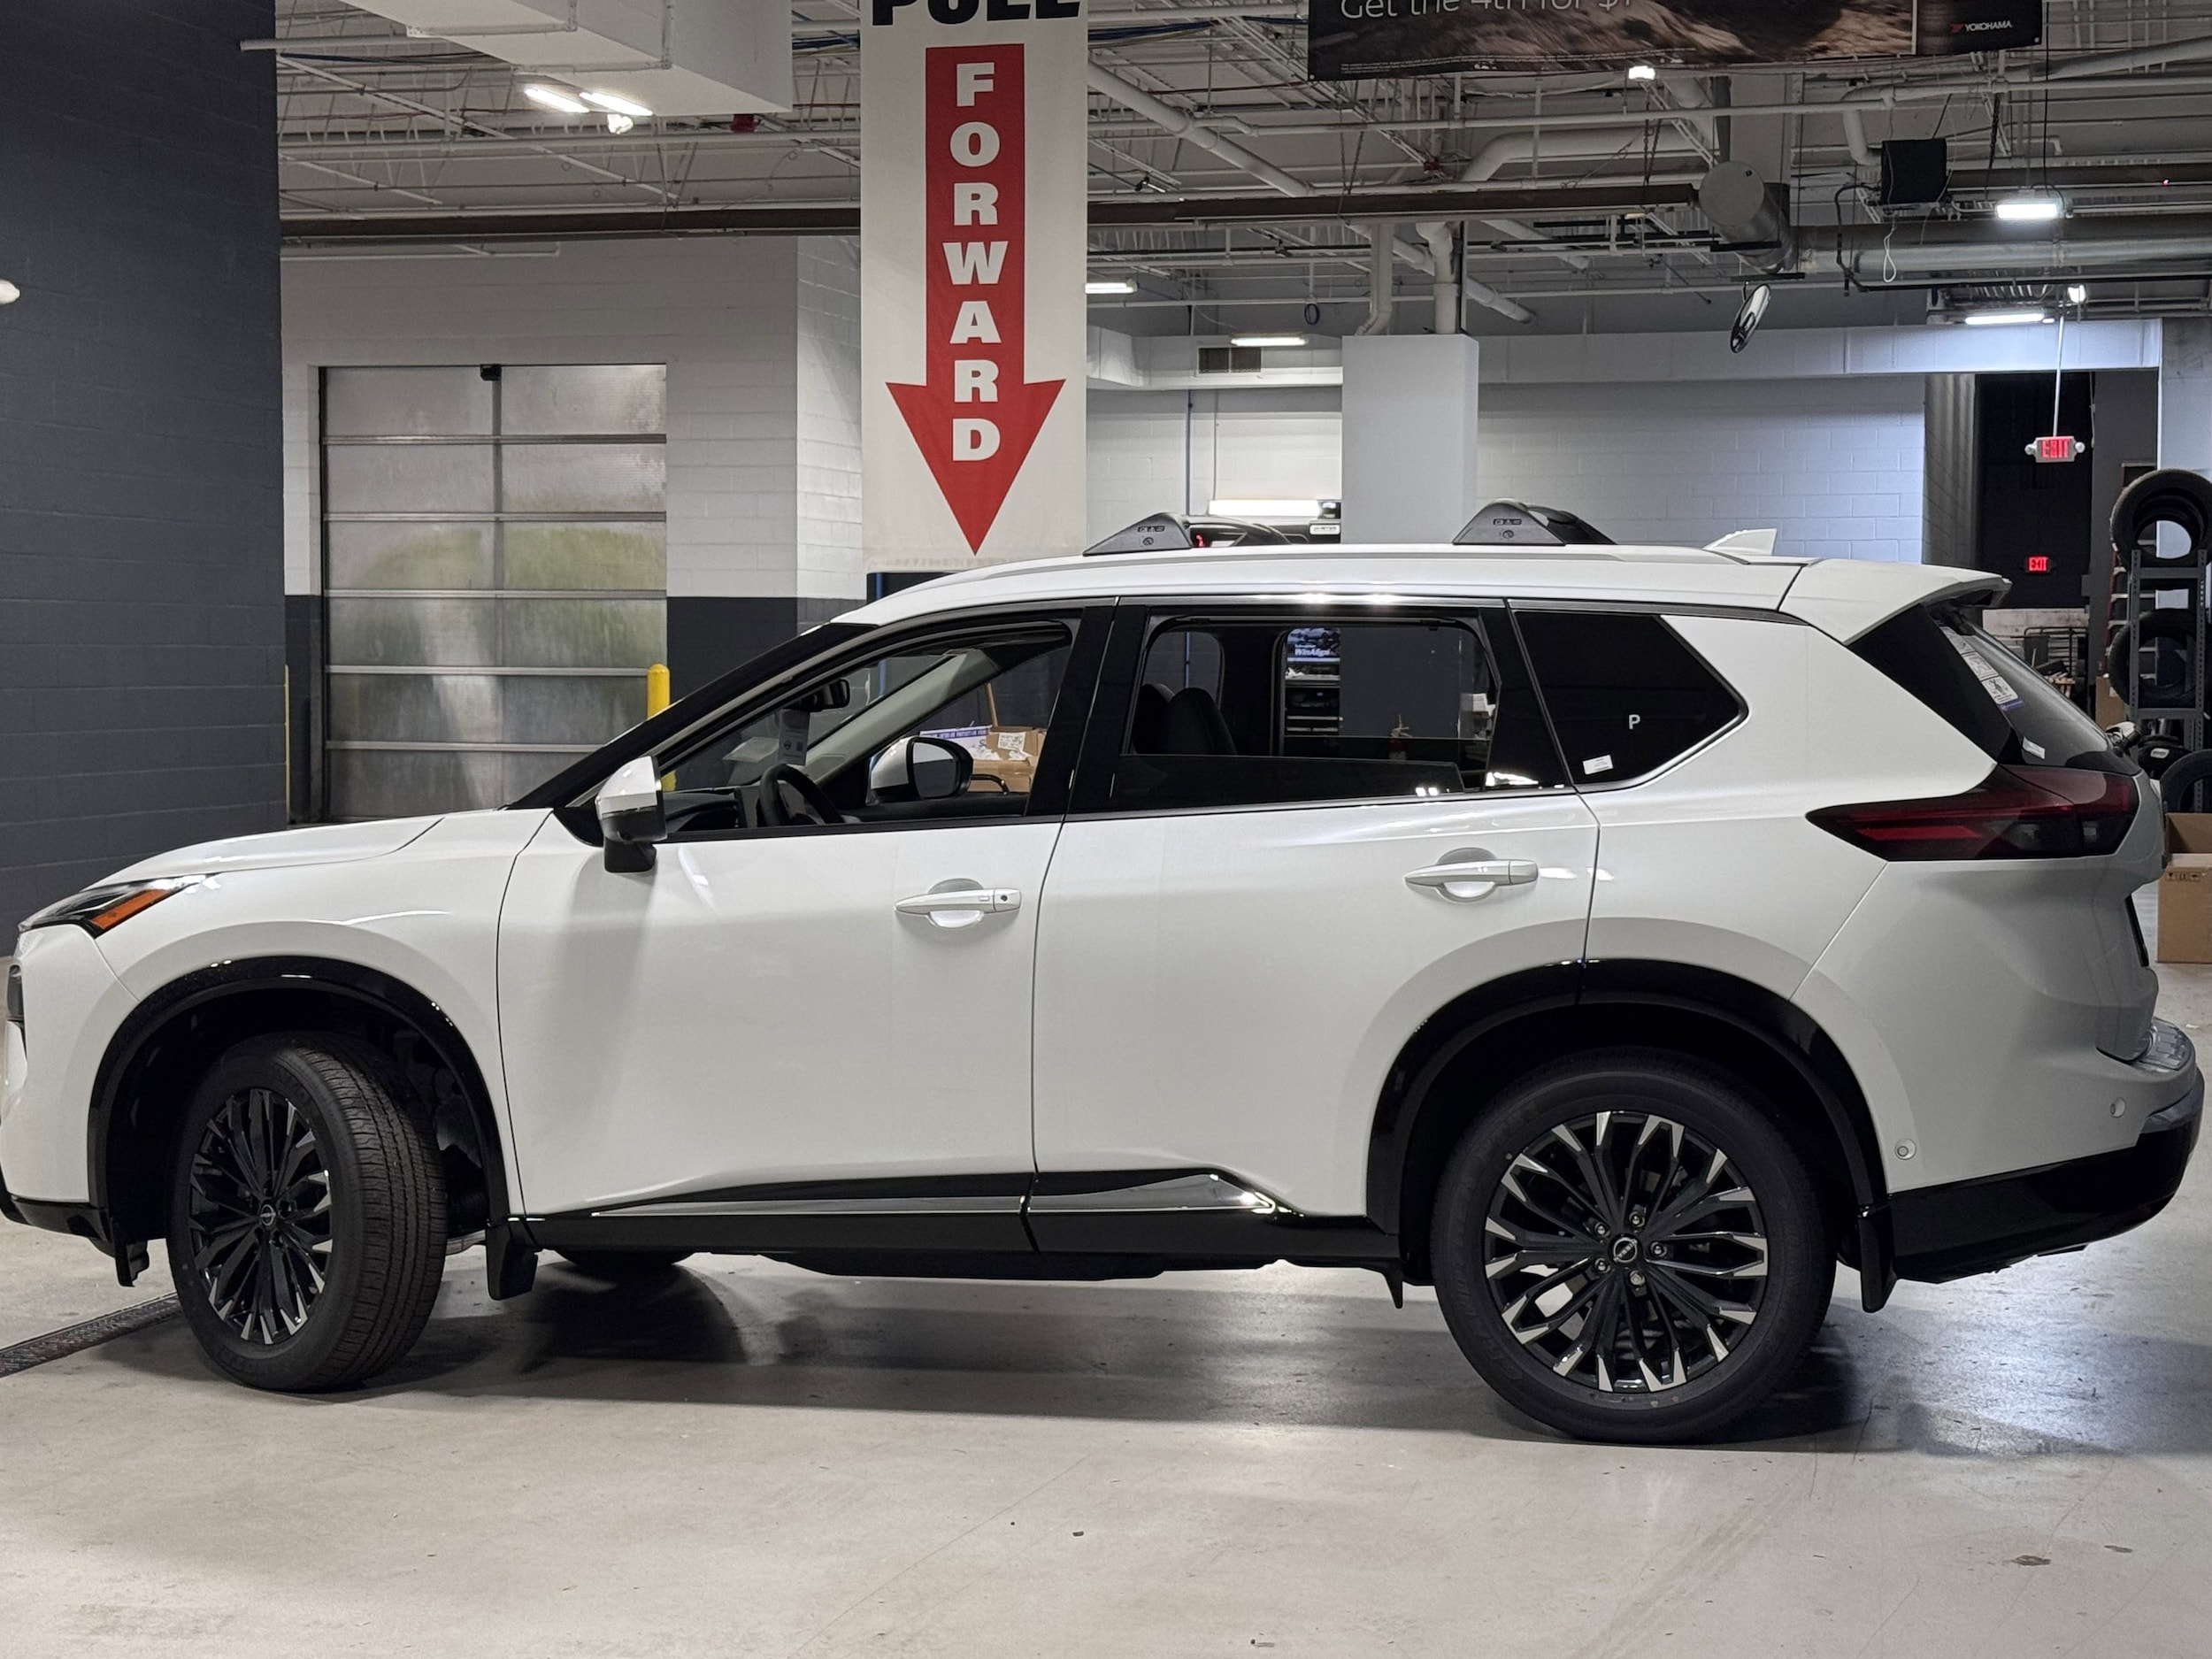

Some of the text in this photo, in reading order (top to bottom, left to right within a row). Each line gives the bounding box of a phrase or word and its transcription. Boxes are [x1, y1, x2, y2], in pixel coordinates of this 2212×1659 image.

[1964, 19, 2014, 32] YOKOHAMA
[942, 62, 1009, 461] FORWARD
[2041, 438, 2070, 458] EXIT
[2029, 557, 2048, 572] EXIT
